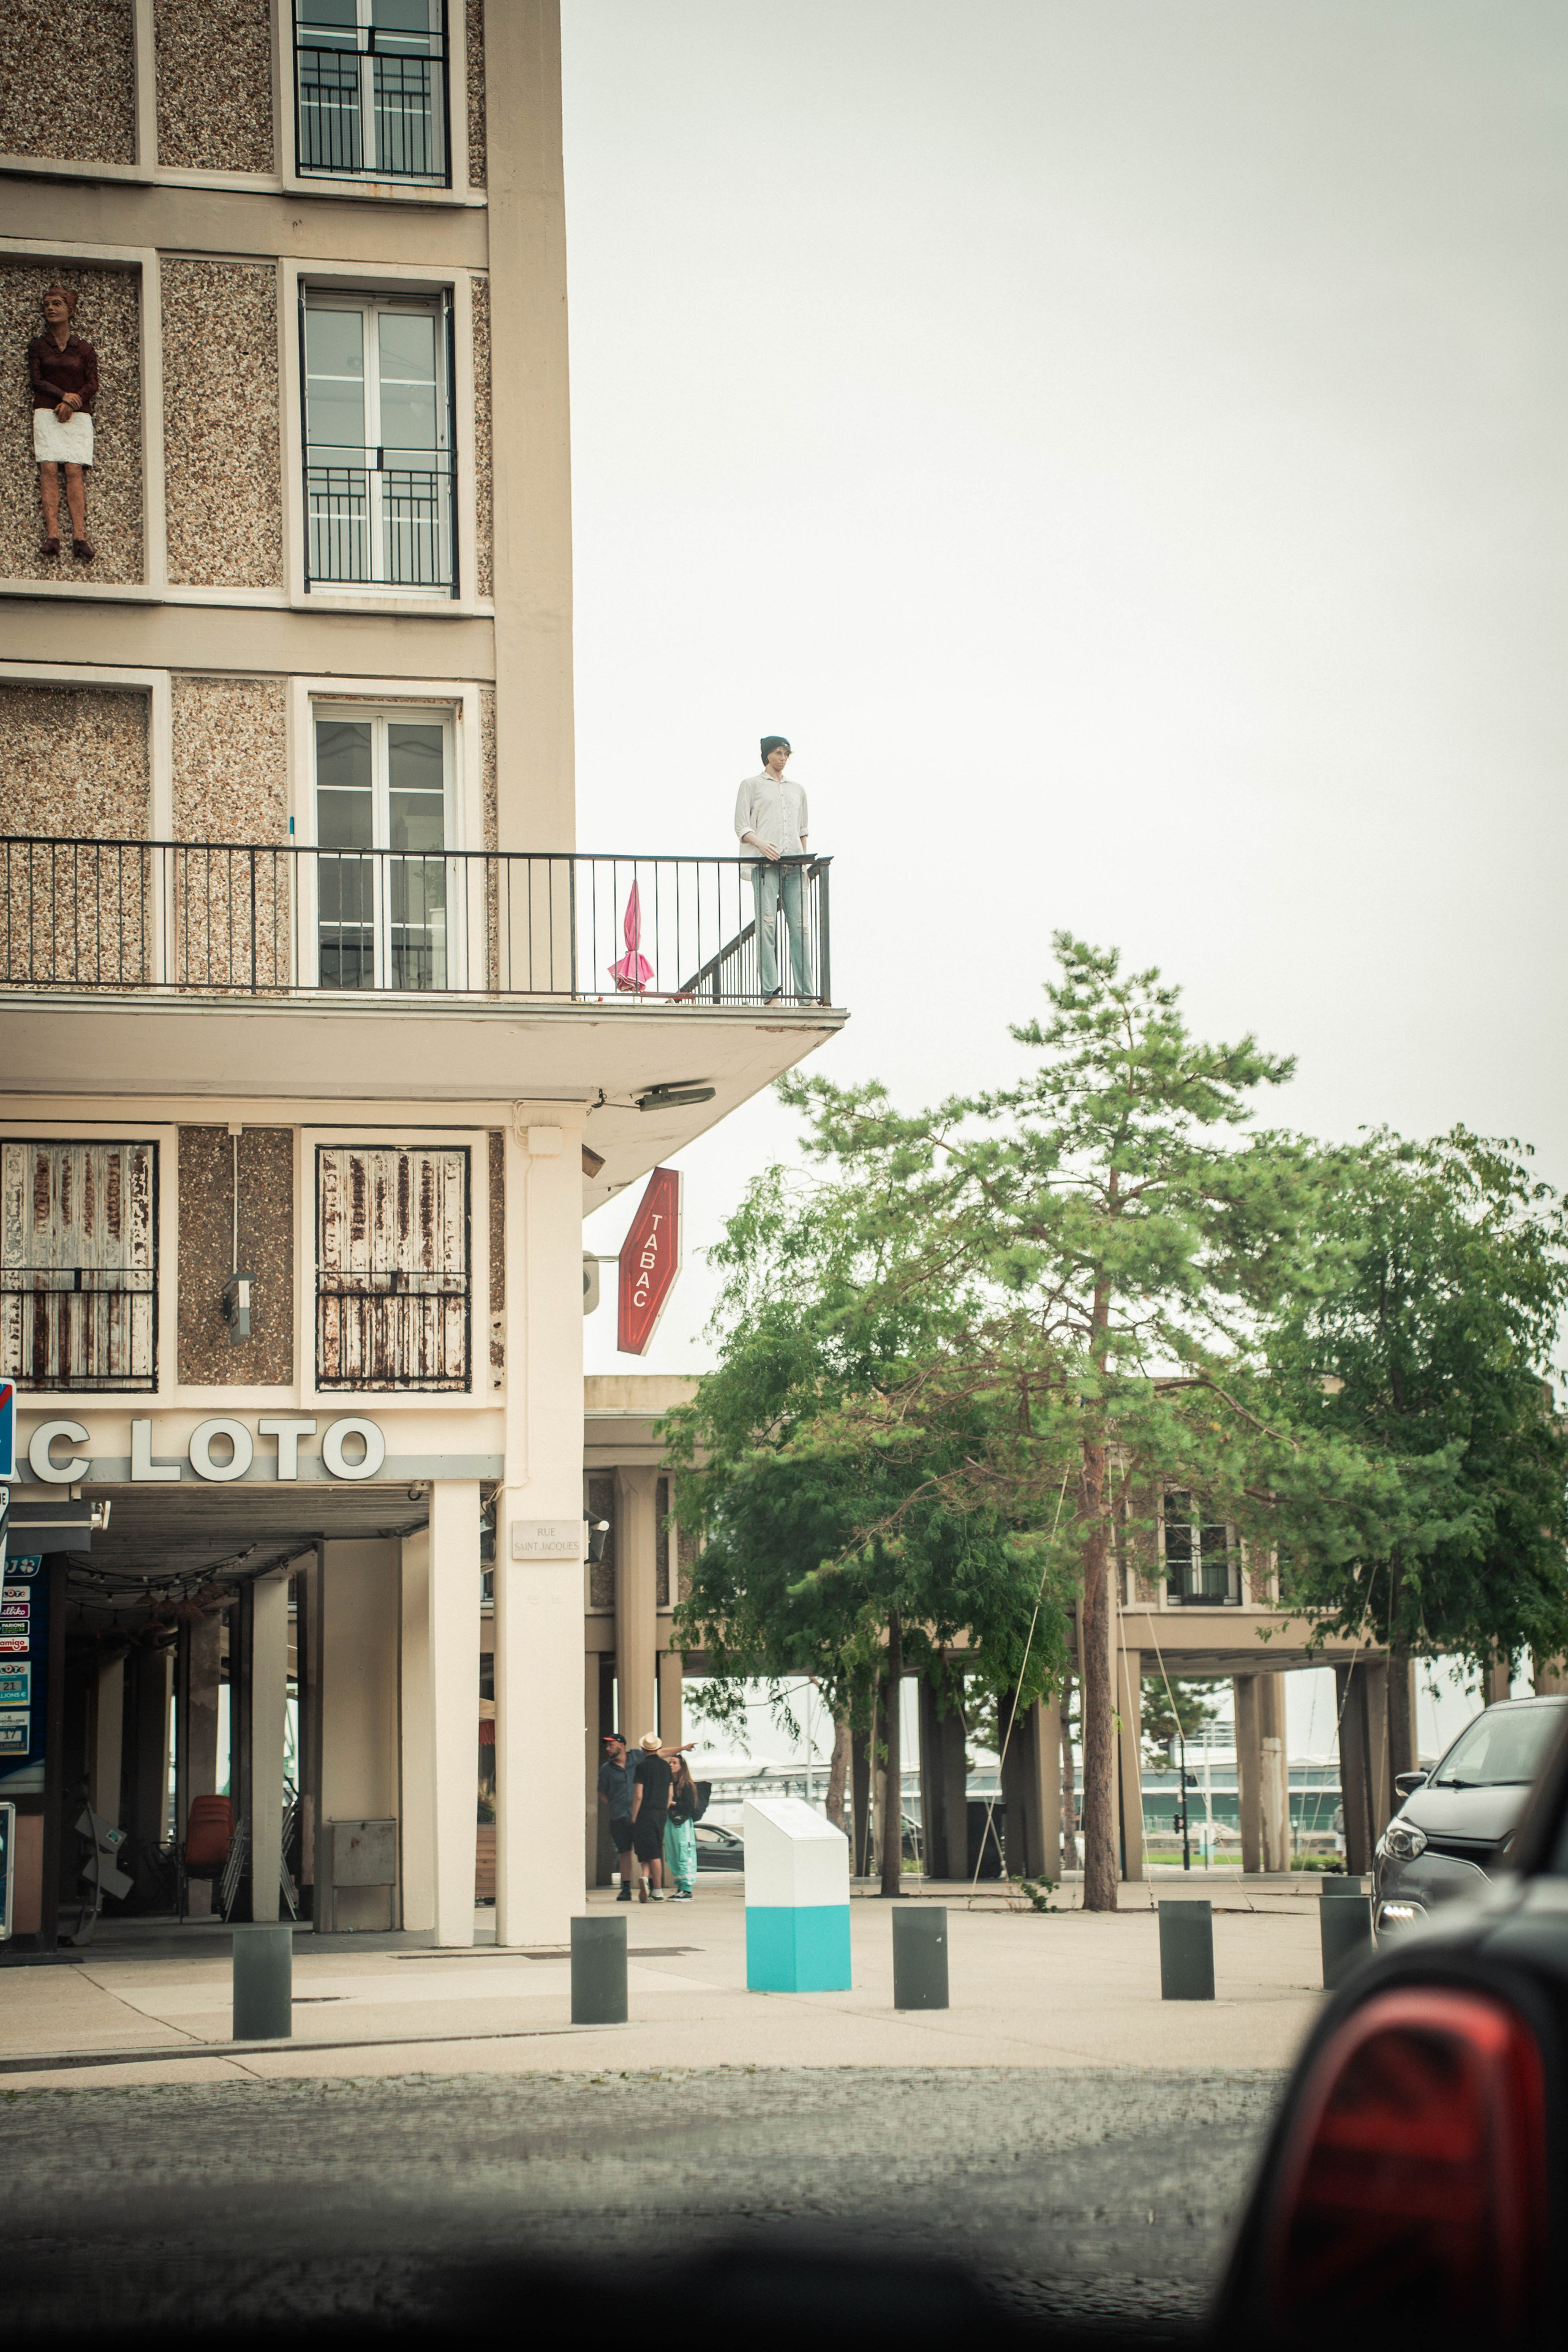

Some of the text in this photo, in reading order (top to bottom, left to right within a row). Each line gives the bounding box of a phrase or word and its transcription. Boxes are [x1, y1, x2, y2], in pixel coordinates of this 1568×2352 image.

[634, 1214, 663, 1307] TABAC
[15, 1417, 386, 1483] C LOTO
[514, 1542, 579, 1551] SAINT JACQUES
[0, 1639, 24, 1649] amigo
[3, 1682, 16, 1691] 21
[4, 1730, 16, 1739] 17
